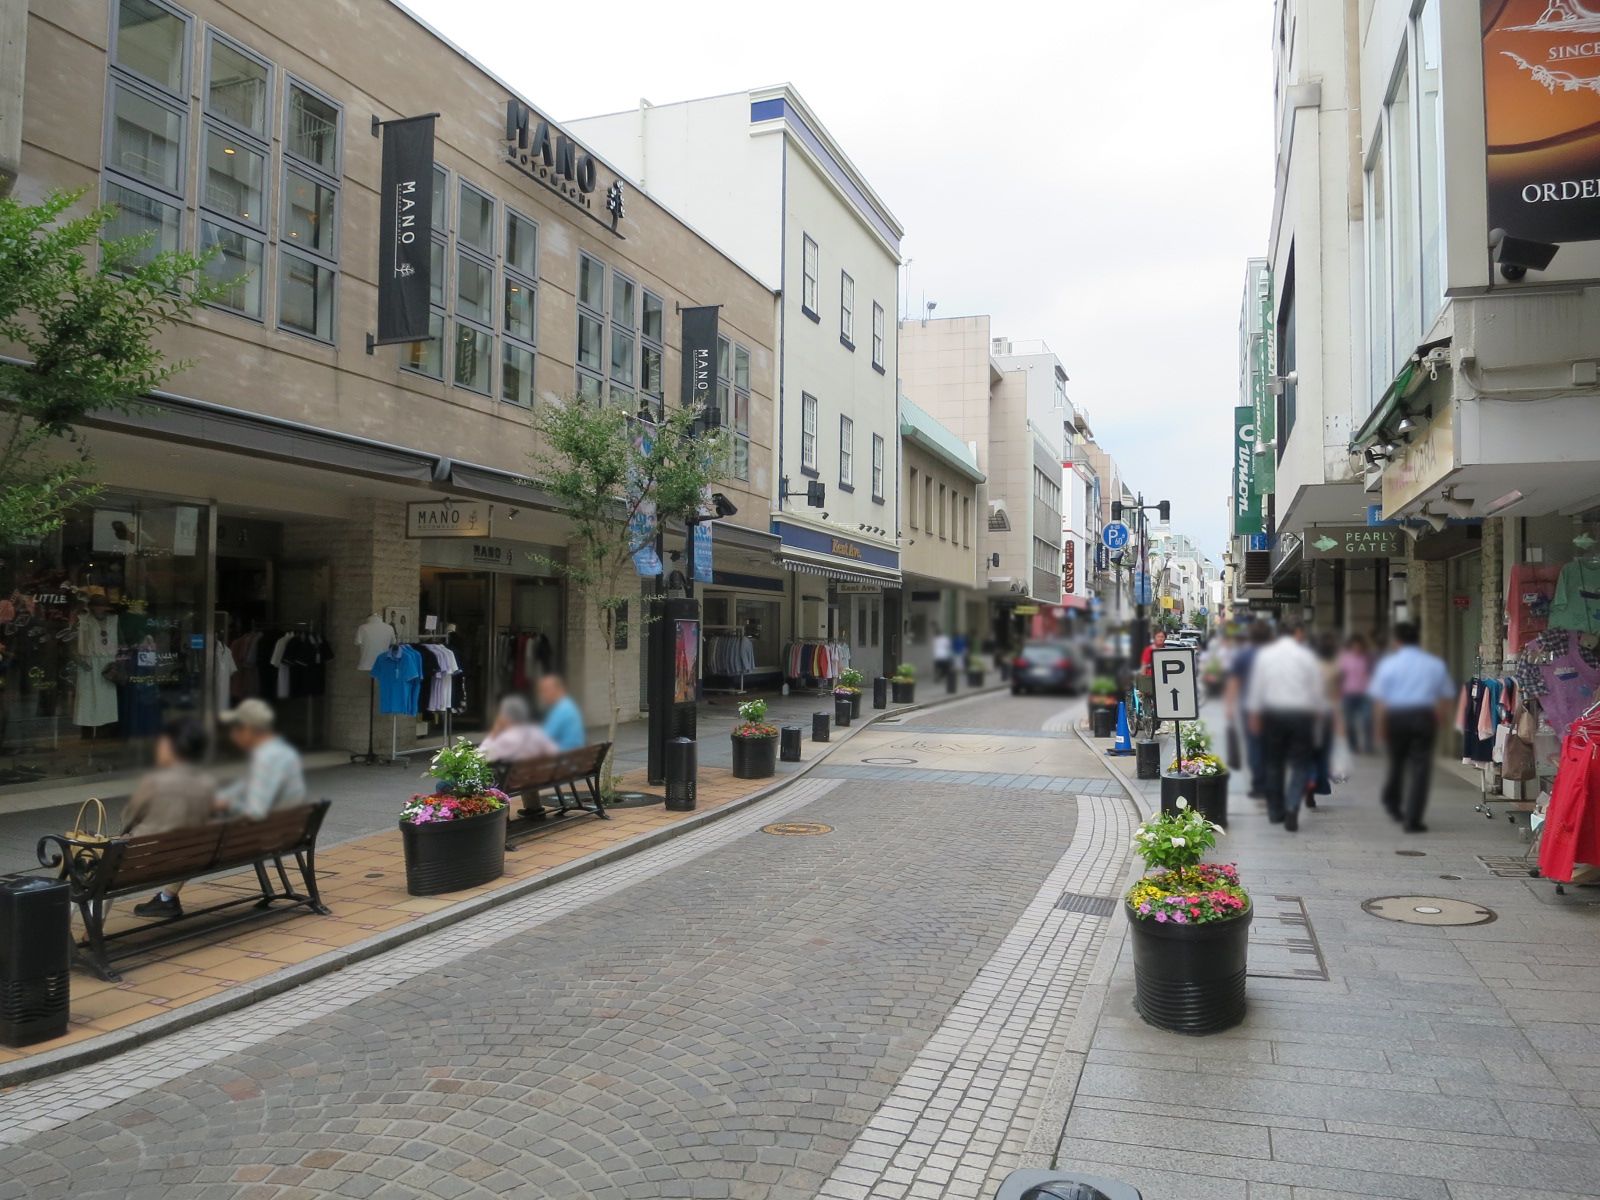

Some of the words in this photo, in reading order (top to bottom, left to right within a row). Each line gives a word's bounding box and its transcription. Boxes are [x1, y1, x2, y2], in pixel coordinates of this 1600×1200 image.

[506, 99, 597, 194] MANO
[402, 181, 416, 244] MANO
[698, 349, 709, 390] MANO
[1238, 443, 1254, 517] union
[418, 510, 460, 524] MANO
[1108, 529, 1119, 546] P
[1346, 532, 1398, 541] PEARLY
[473, 545, 501, 558] MANO
[1346, 543, 1398, 552] GATES
[32, 593, 68, 604] LITTLE
[1161, 659, 1186, 685] P
